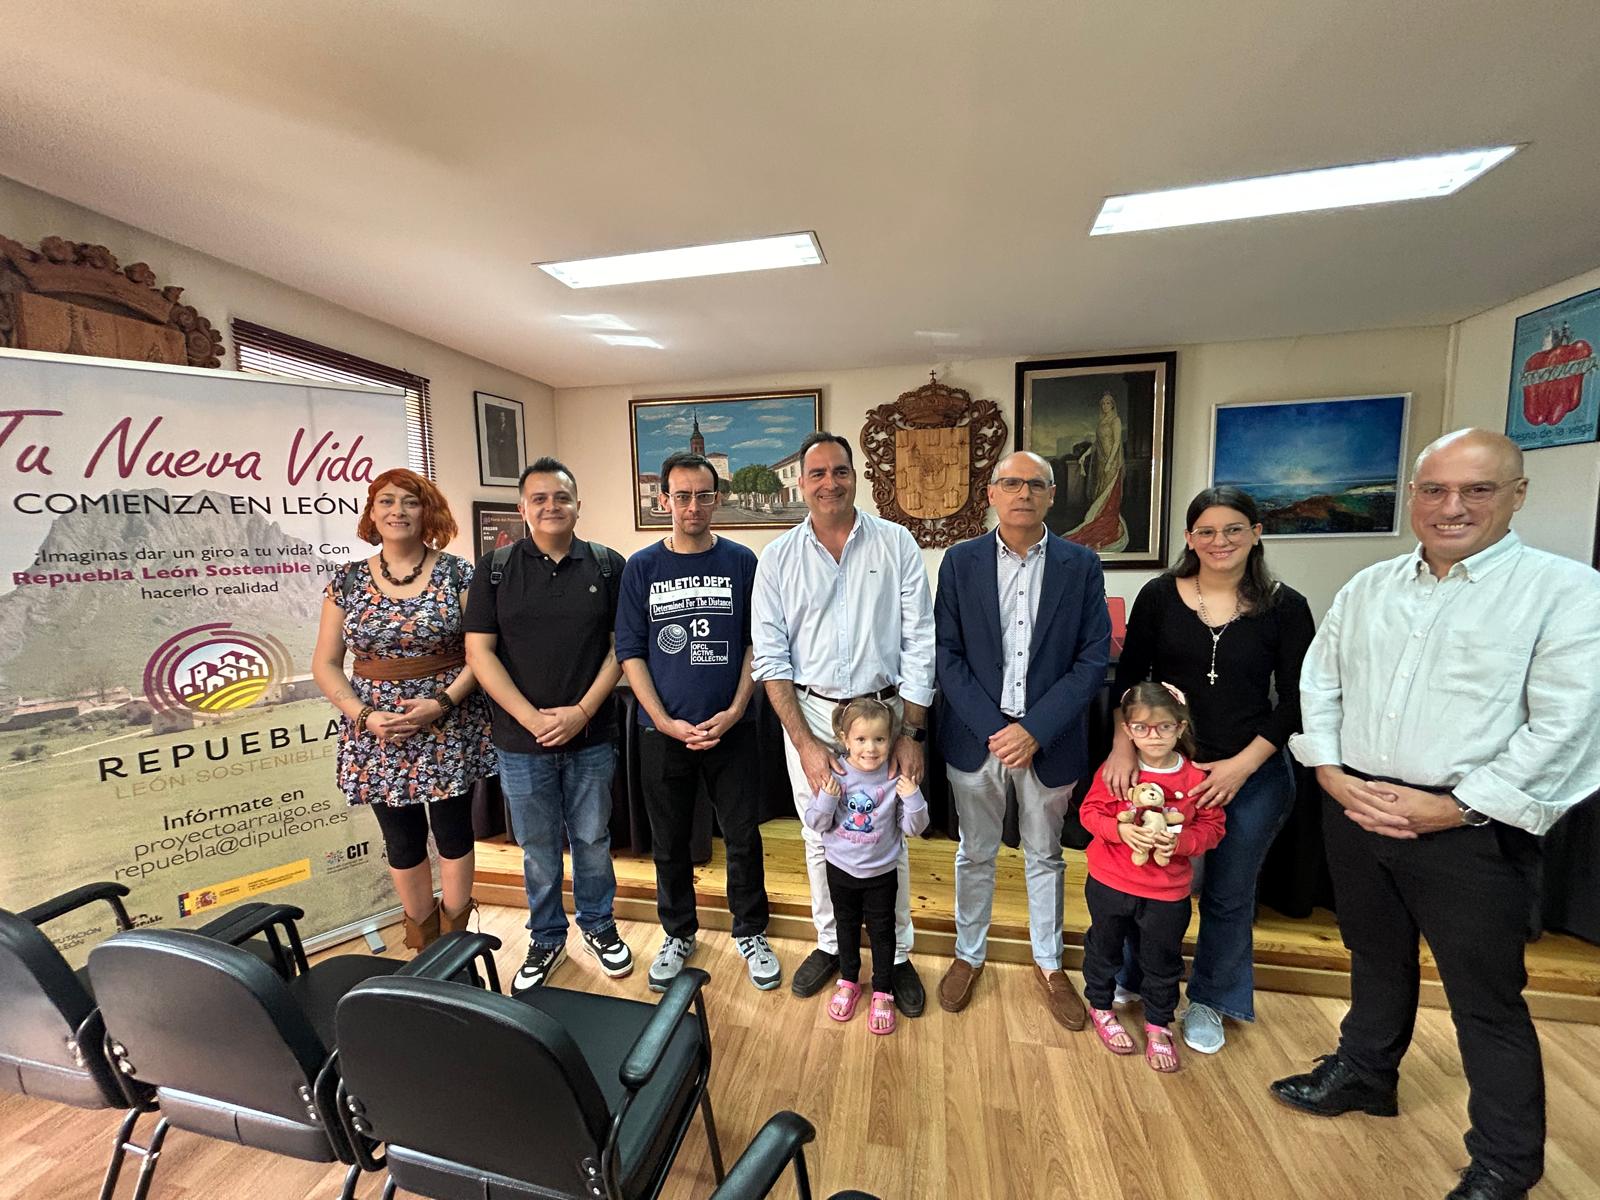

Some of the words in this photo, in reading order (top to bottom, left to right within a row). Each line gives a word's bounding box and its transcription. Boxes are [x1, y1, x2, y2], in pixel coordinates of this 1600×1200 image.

[0, 410, 63, 475] Tu
[84, 416, 262, 481] Nueva
[287, 427, 373, 486] Vida
[13, 493, 220, 514] COMIENZA
[230, 496, 272, 515] EN
[282, 492, 359, 515] LEÓN
[34, 549, 128, 566] ¿Imaginas
[135, 548, 166, 560] dar
[173, 549, 195, 559] un
[201, 546, 234, 561] giro
[240, 548, 249, 557] a
[255, 546, 271, 557] tu
[276, 543, 313, 556] vida?
[319, 543, 350, 555] Con
[12, 567, 135, 588] Repuebla
[142, 565, 199, 580] León
[206, 562, 311, 577] Sostenible
[316, 561, 349, 575] pue
[650, 577, 700, 594] ATHLETIC
[703, 575, 733, 588] DEPT.
[141, 584, 208, 599] hacerlo
[215, 580, 279, 595] realidad
[653, 599, 685, 613] Determined
[686, 598, 696, 608] For
[696, 597, 707, 607] The
[708, 597, 731, 607] Distance
[689, 618, 710, 637] 13
[98, 719, 340, 782] REPUEBLA
[115, 772, 185, 800] LEÓN
[196, 744, 335, 783] SOSTENIBLE
[163, 795, 273, 831] Infórmate
[281, 788, 304, 802] en
[134, 799, 331, 861] proyectoarraigo.es
[114, 810, 349, 880] repuebla@dipuleon.es
[346, 841, 369, 860] CIT
